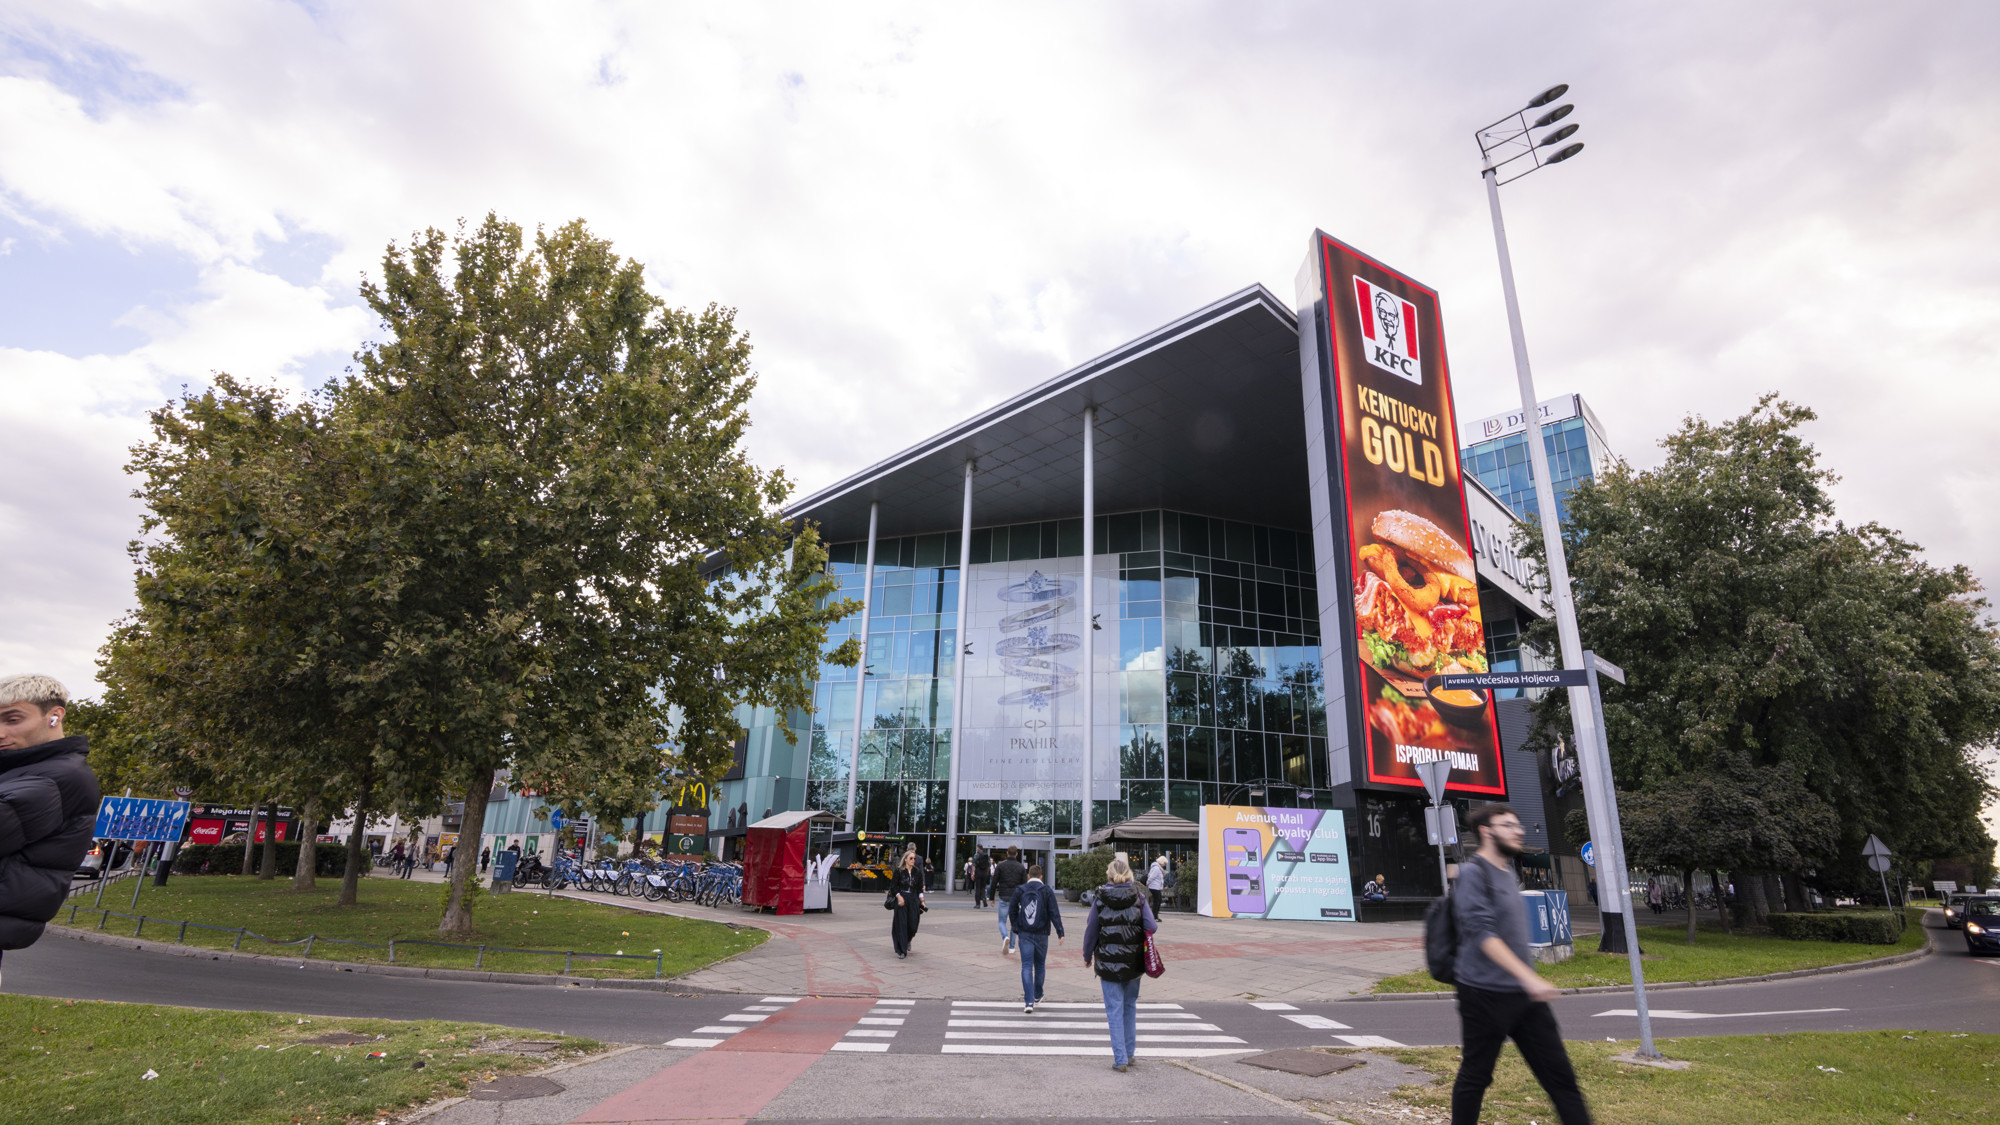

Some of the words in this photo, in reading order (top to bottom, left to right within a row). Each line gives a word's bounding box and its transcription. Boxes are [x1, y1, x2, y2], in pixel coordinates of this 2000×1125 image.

[1374, 345, 1413, 377] KFC
[1357, 383, 1438, 439] KENTUCKY
[1360, 416, 1445, 487] GOLD
[1521, 674, 1560, 685] Holjevca
[1010, 738, 1058, 749] PRAHIR
[972, 781, 1009, 790] wedding
[1010, 781, 1017, 789] &
[1018, 781, 1073, 791] engagement
[1235, 811, 1278, 824] Avenue
[1279, 813, 1304, 825] Mall
[1367, 813, 1381, 838] 16
[1271, 826, 1312, 841] Loyalty
[1314, 828, 1339, 839] Club
[1325, 876, 1348, 886] sjajne
[1274, 885, 1307, 895] popuste
